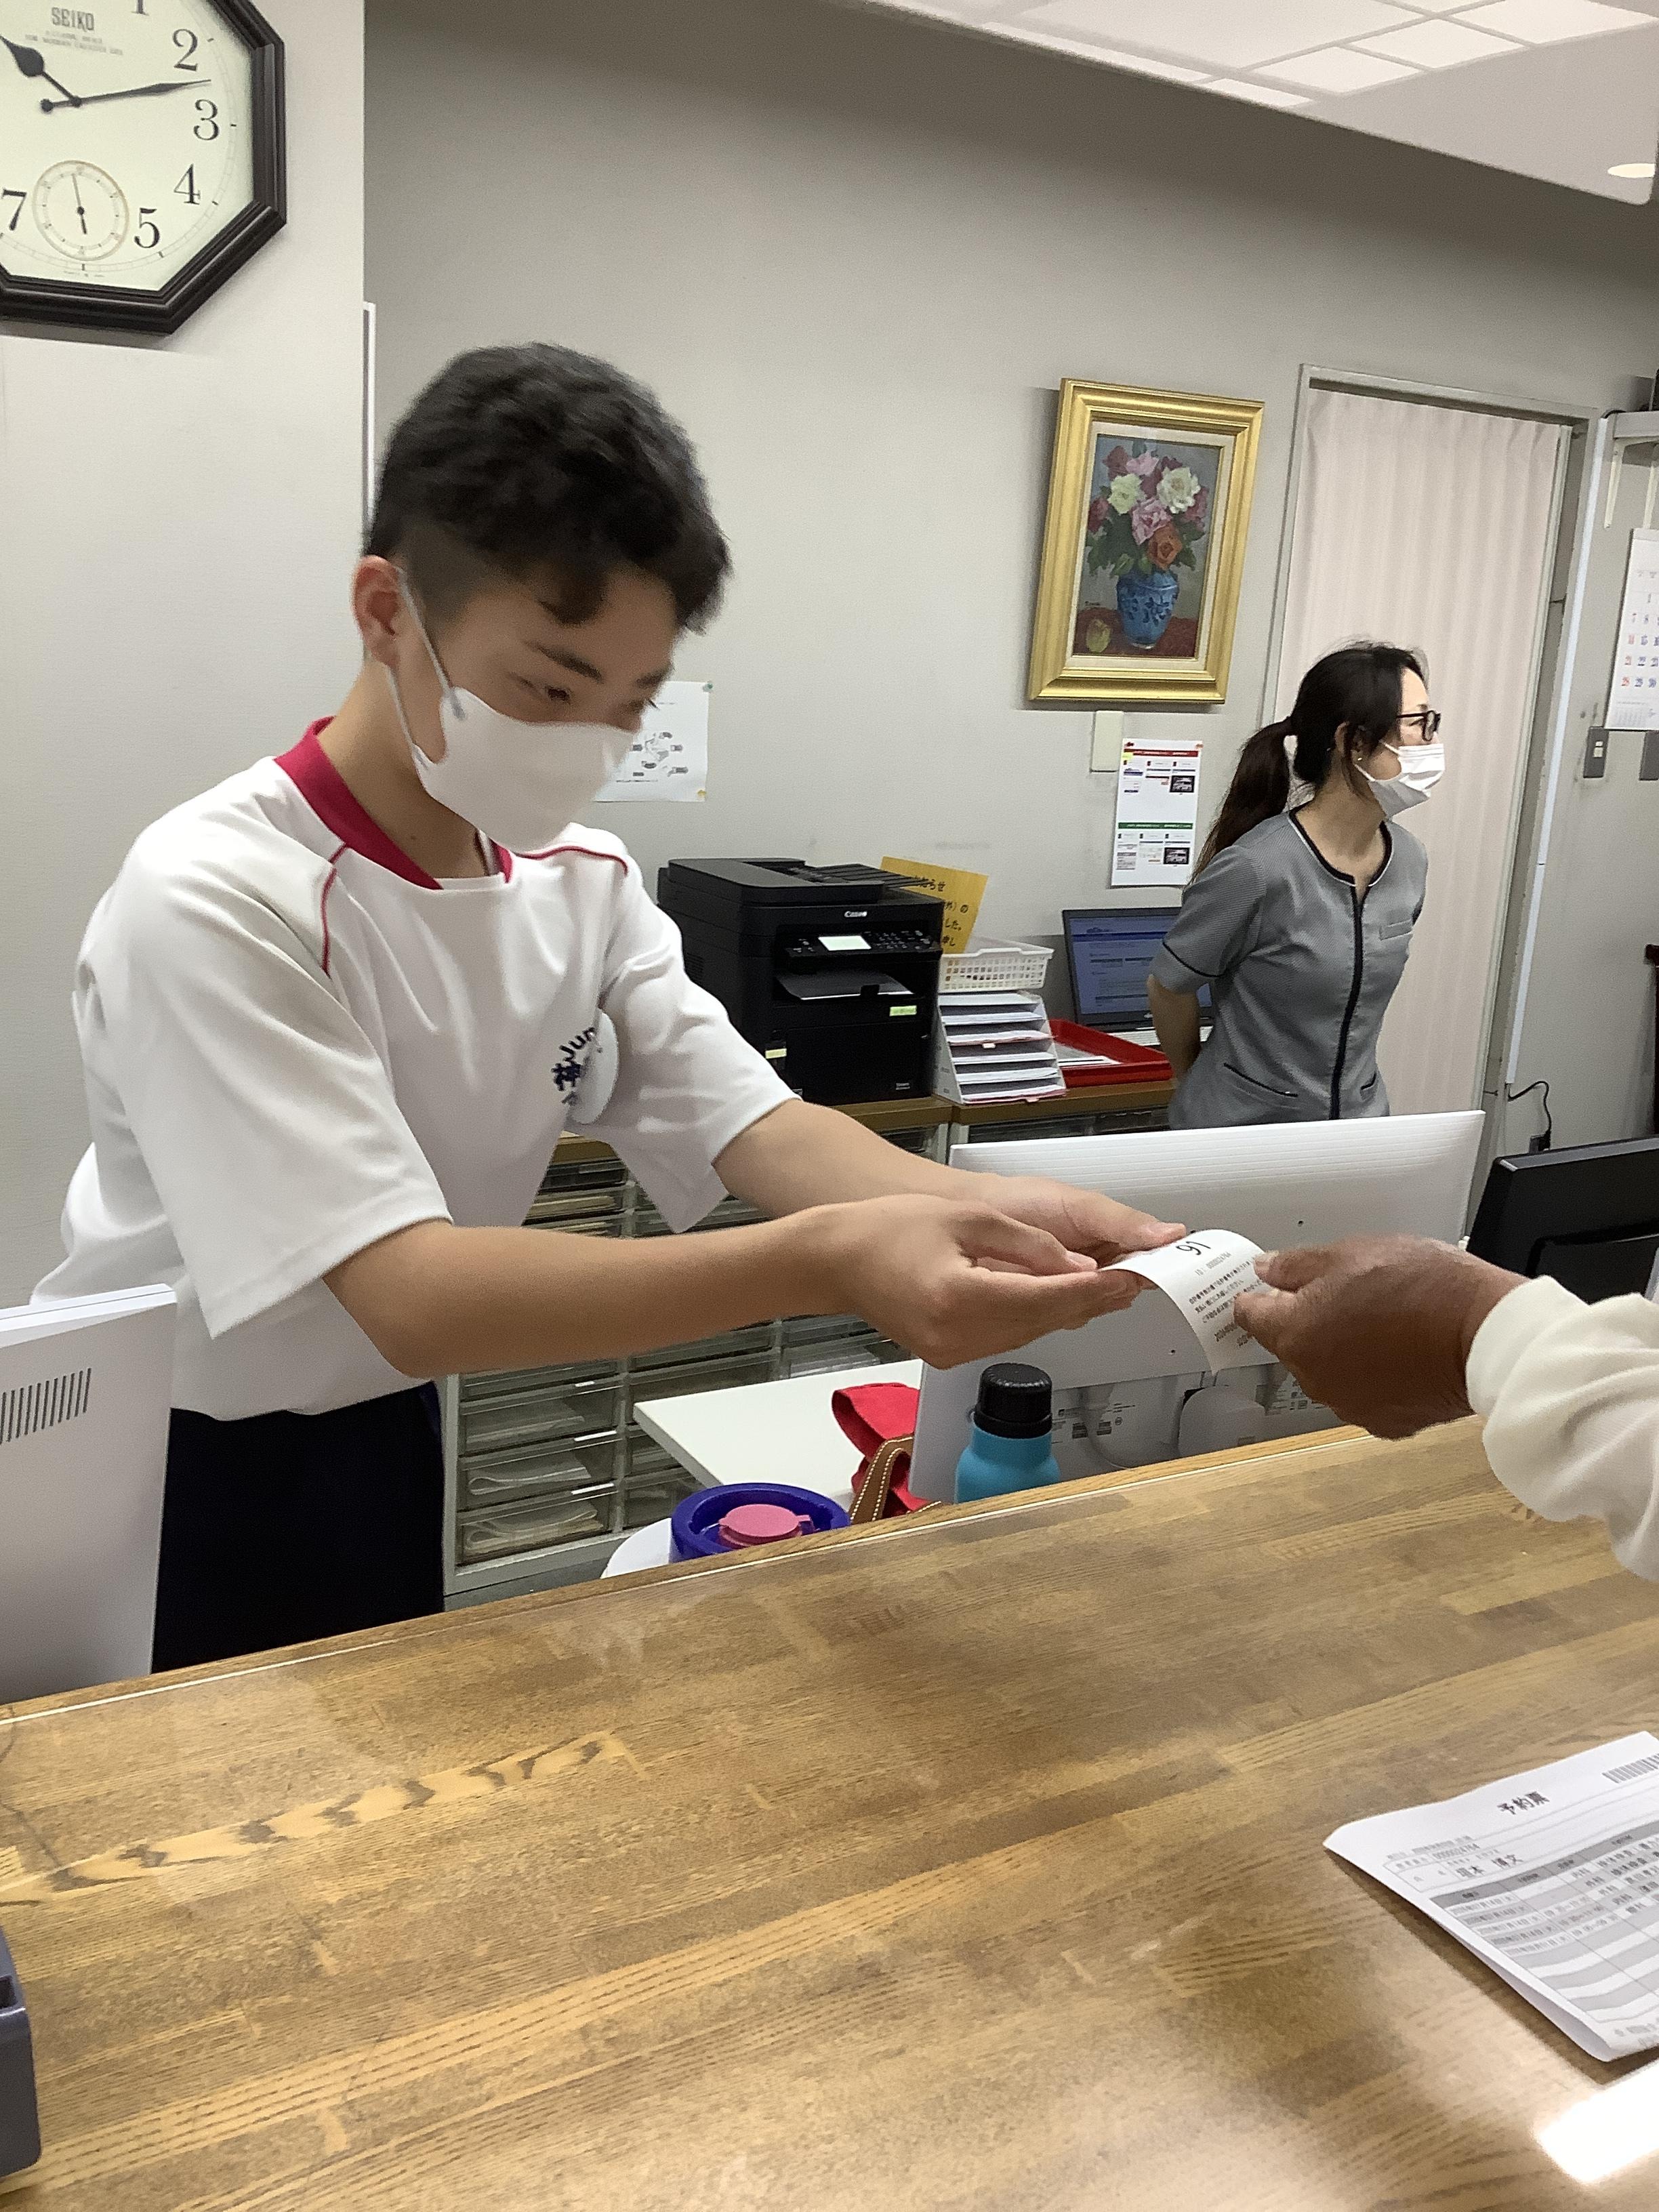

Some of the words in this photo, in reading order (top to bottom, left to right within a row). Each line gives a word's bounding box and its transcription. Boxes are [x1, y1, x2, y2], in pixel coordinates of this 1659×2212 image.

[51, 7, 95, 33] SEIKO
[172, 28, 199, 72] 2
[193, 99, 220, 141] 3
[173, 164, 201, 205] 4
[1, 188, 27, 231] 7
[134, 207, 161, 249] 5
[1176, 1240, 1212, 1256] 91
[1496, 1790, 1550, 1815] 予約票
